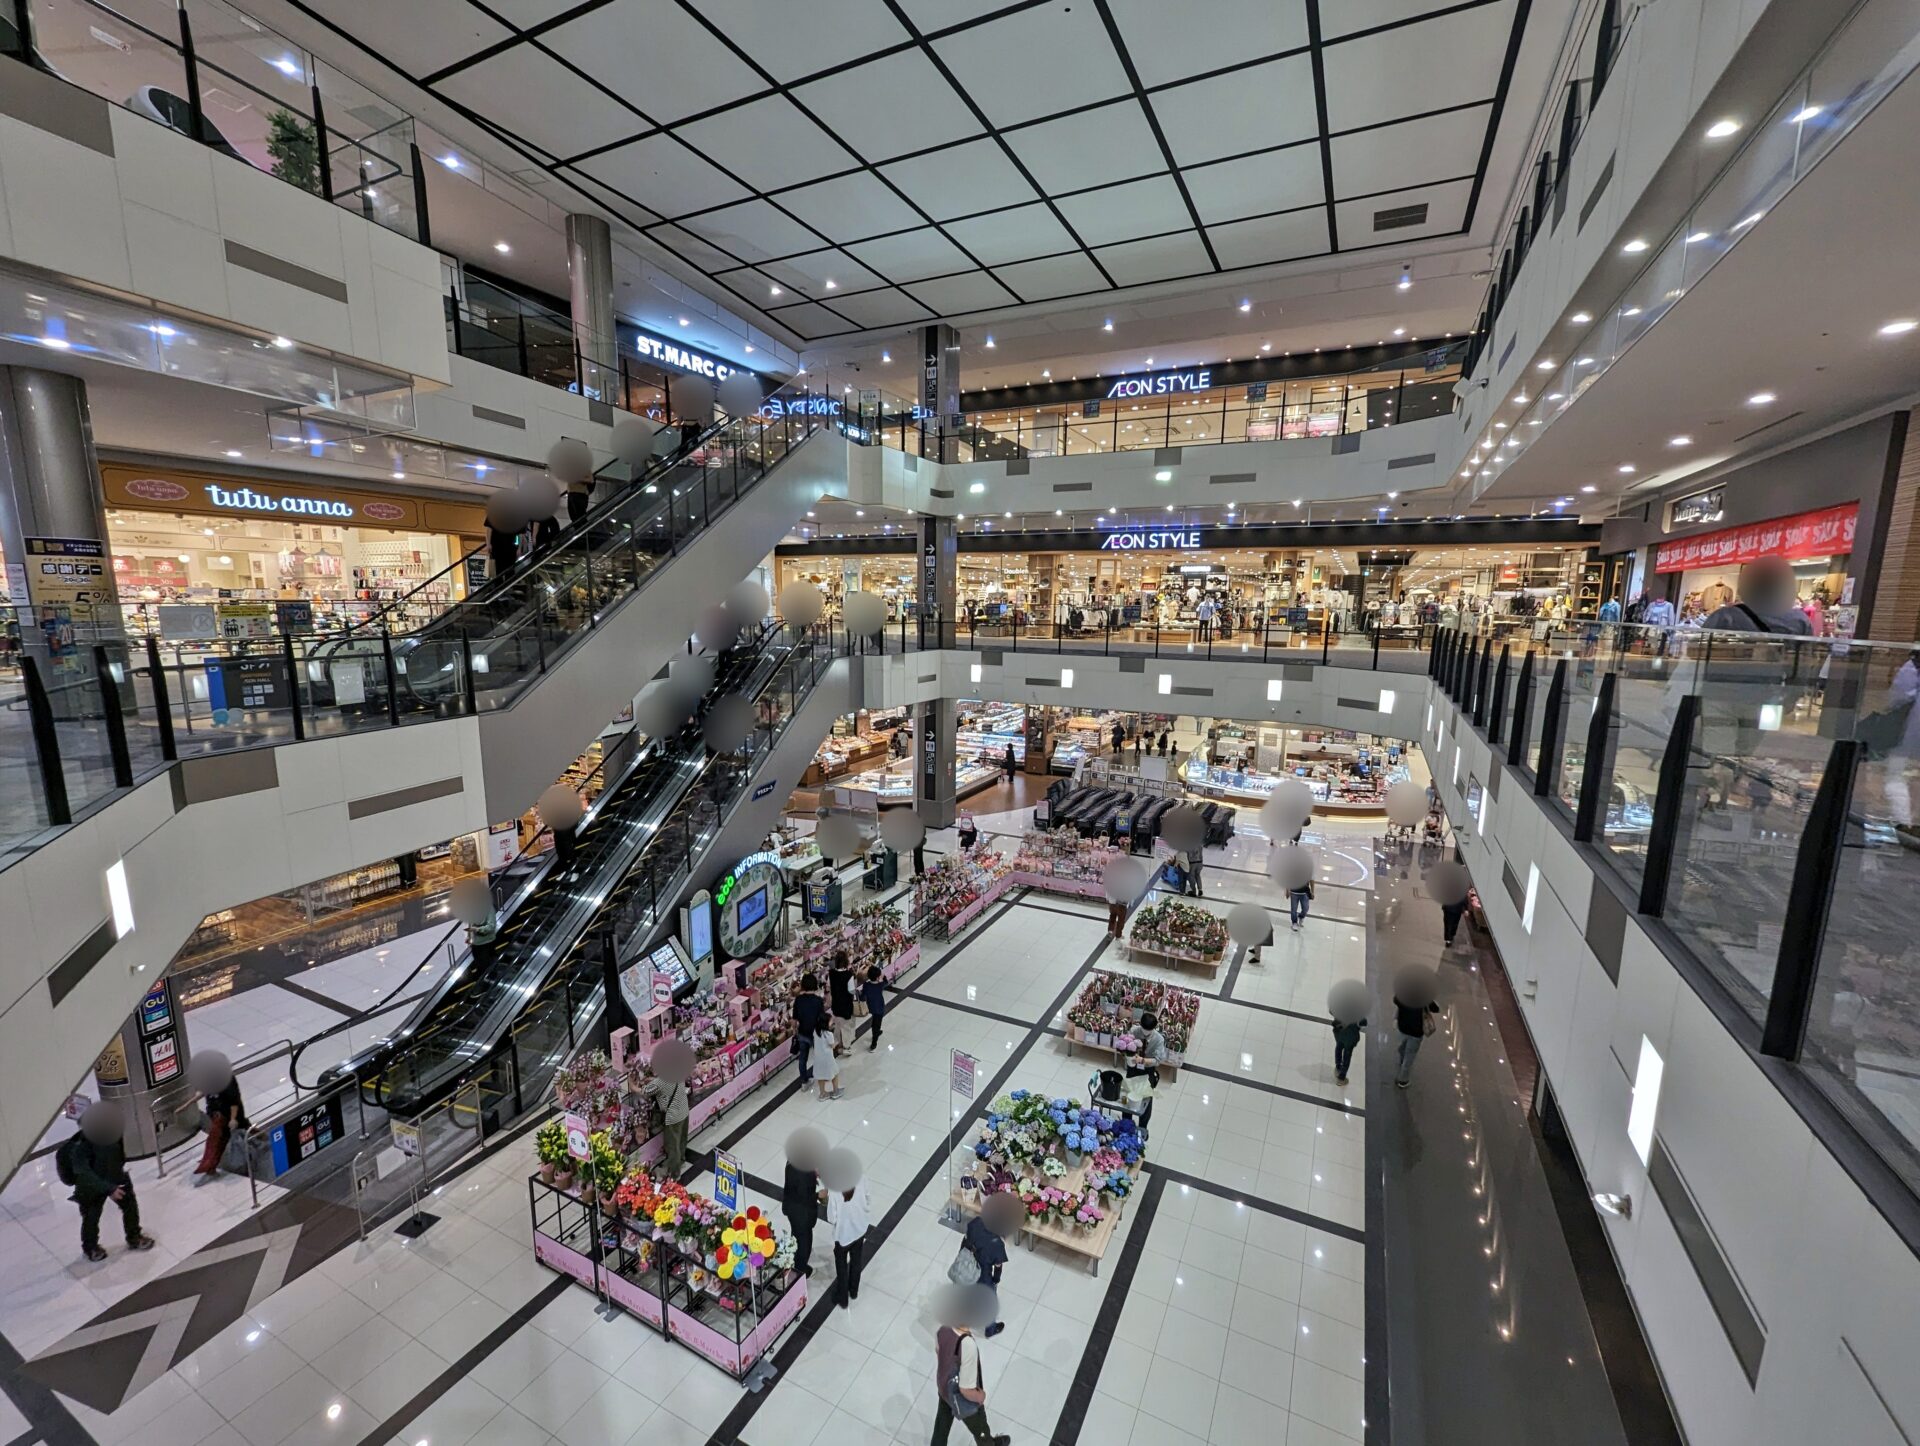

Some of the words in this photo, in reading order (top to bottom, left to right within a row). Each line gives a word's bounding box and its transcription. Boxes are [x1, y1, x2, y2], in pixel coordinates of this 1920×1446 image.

[637, 335, 715, 377] ST.MARC
[1156, 372, 1210, 393] STYLE
[205, 484, 278, 510] tutu
[281, 496, 353, 517] anna
[1149, 532, 1200, 548] STYLE
[42, 564, 102, 575] 感謝デー
[716, 875, 735, 906] eco
[734, 851, 782, 878] INFORMATION
[145, 995, 165, 1009] GU
[156, 1033, 168, 1041] 1F
[273, 1130, 283, 1142] B
